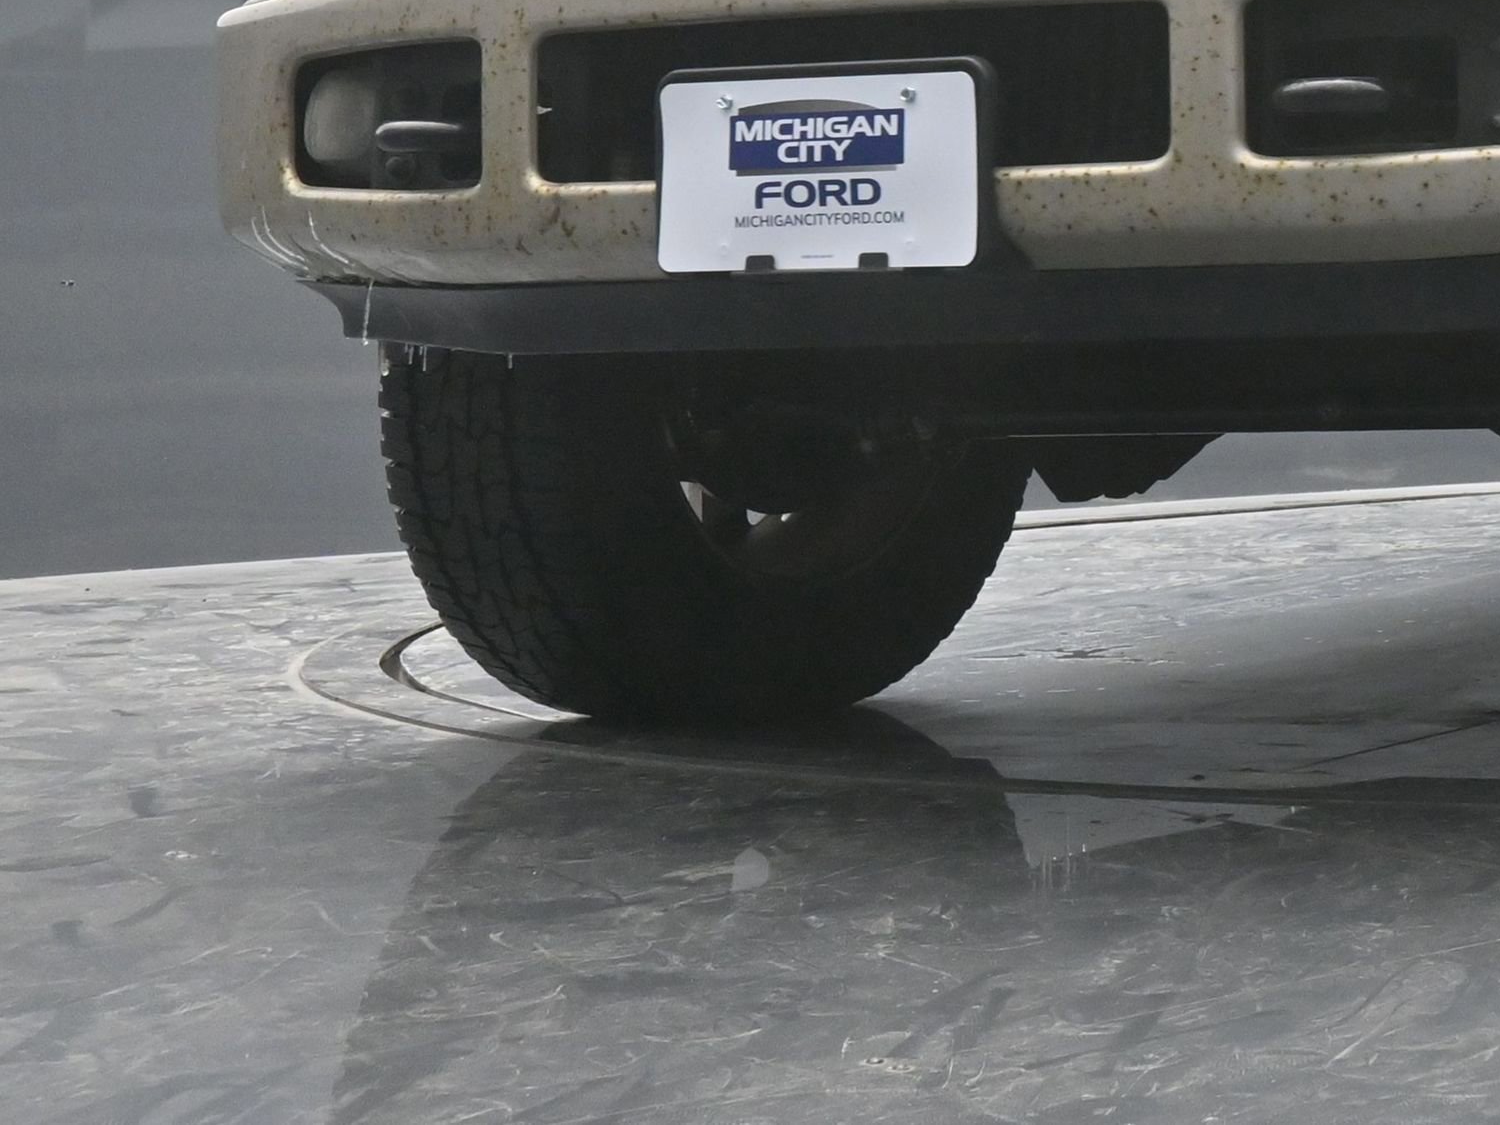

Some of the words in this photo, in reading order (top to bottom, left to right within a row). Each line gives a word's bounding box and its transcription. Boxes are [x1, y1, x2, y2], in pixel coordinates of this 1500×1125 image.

[735, 114, 898, 142] MICHIGAN
[777, 139, 853, 163] CITY
[754, 178, 881, 209] FORD
[735, 211, 905, 229] MICHIGANCITYFORD.COM
